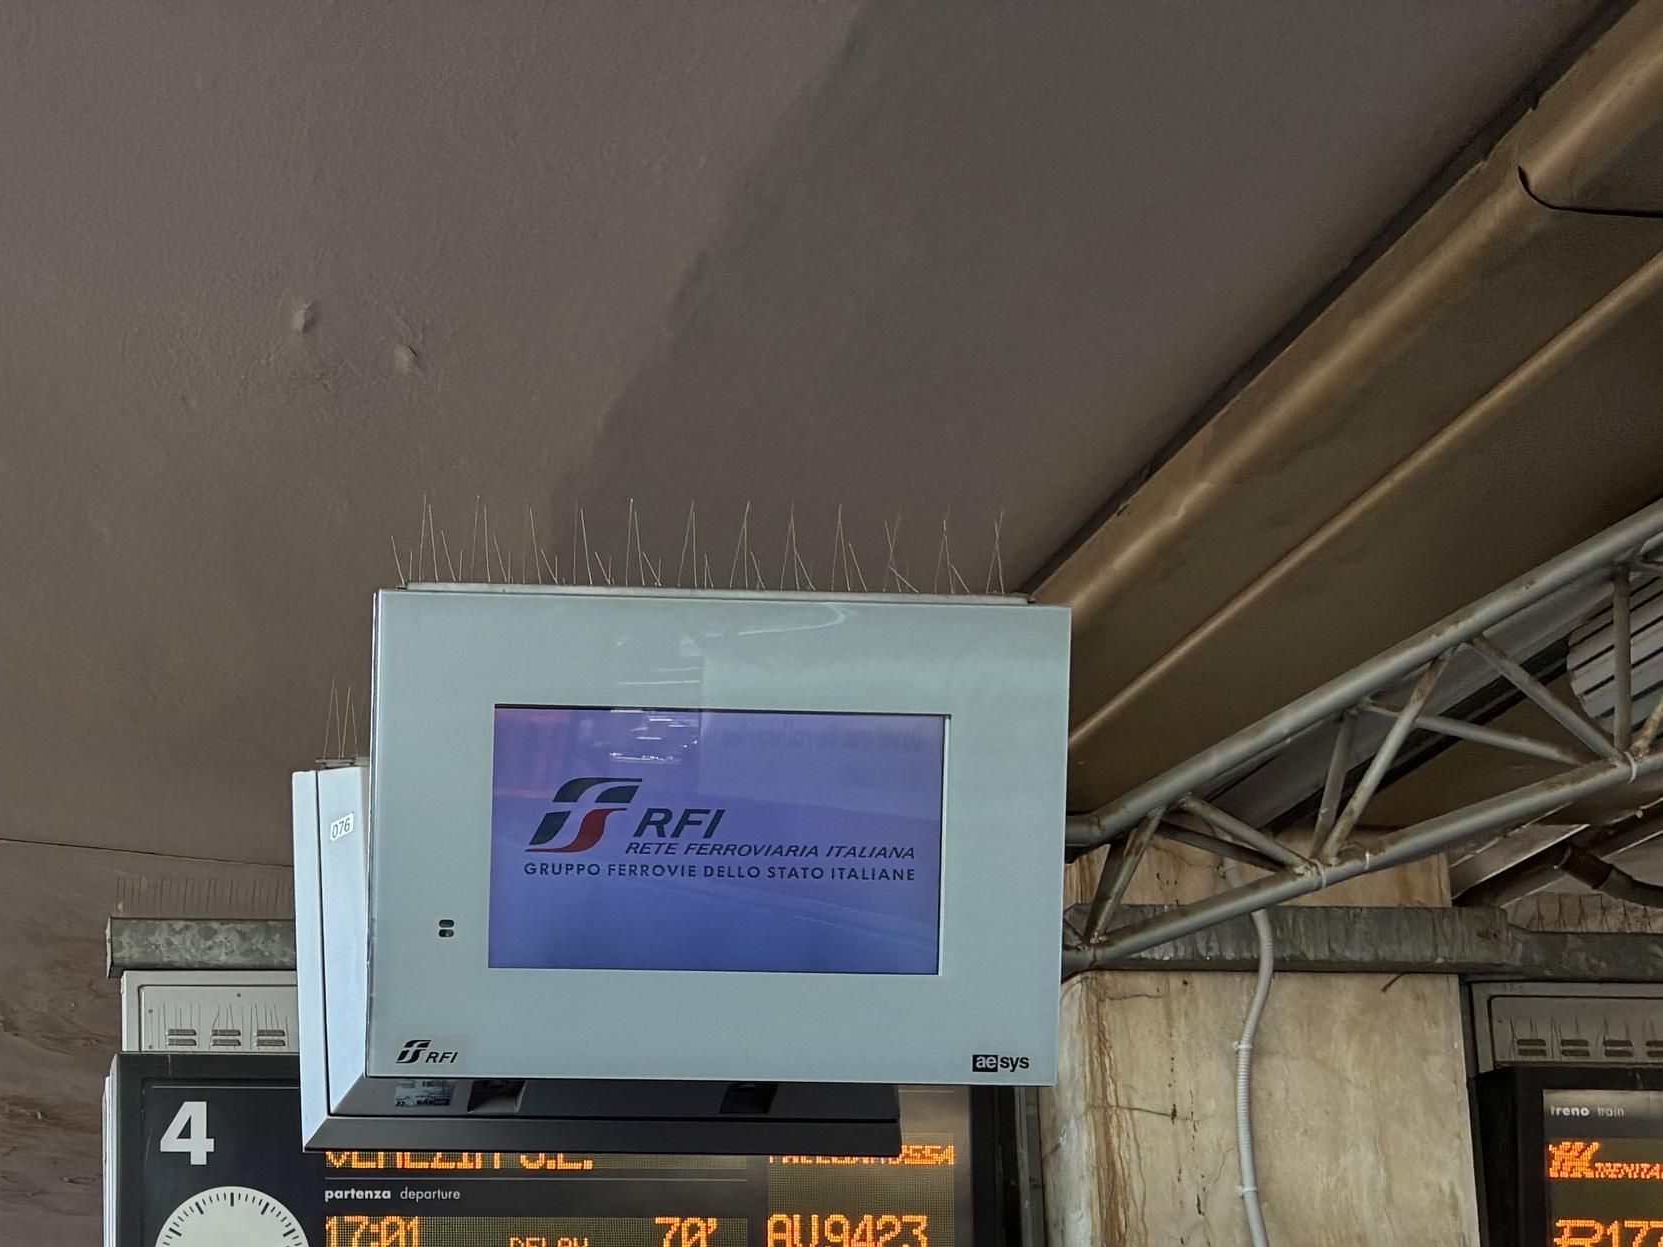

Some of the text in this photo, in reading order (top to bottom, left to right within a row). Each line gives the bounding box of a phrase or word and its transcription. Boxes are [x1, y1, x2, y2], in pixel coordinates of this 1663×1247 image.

[332, 818, 350, 838] 076
[633, 807, 726, 839] RFI
[625, 842, 915, 859] RETE FERROVIARIA ITALIANA
[524, 862, 916, 881] GRUPPO FERROVIE DELLO STATO ITALIANE
[425, 1052, 458, 1063] RFI
[972, 1055, 1030, 1072] aesys
[1550, 1105, 1625, 1117] treno train
[160, 1101, 214, 1166] 4
[324, 1187, 461, 1202] partenza departure
